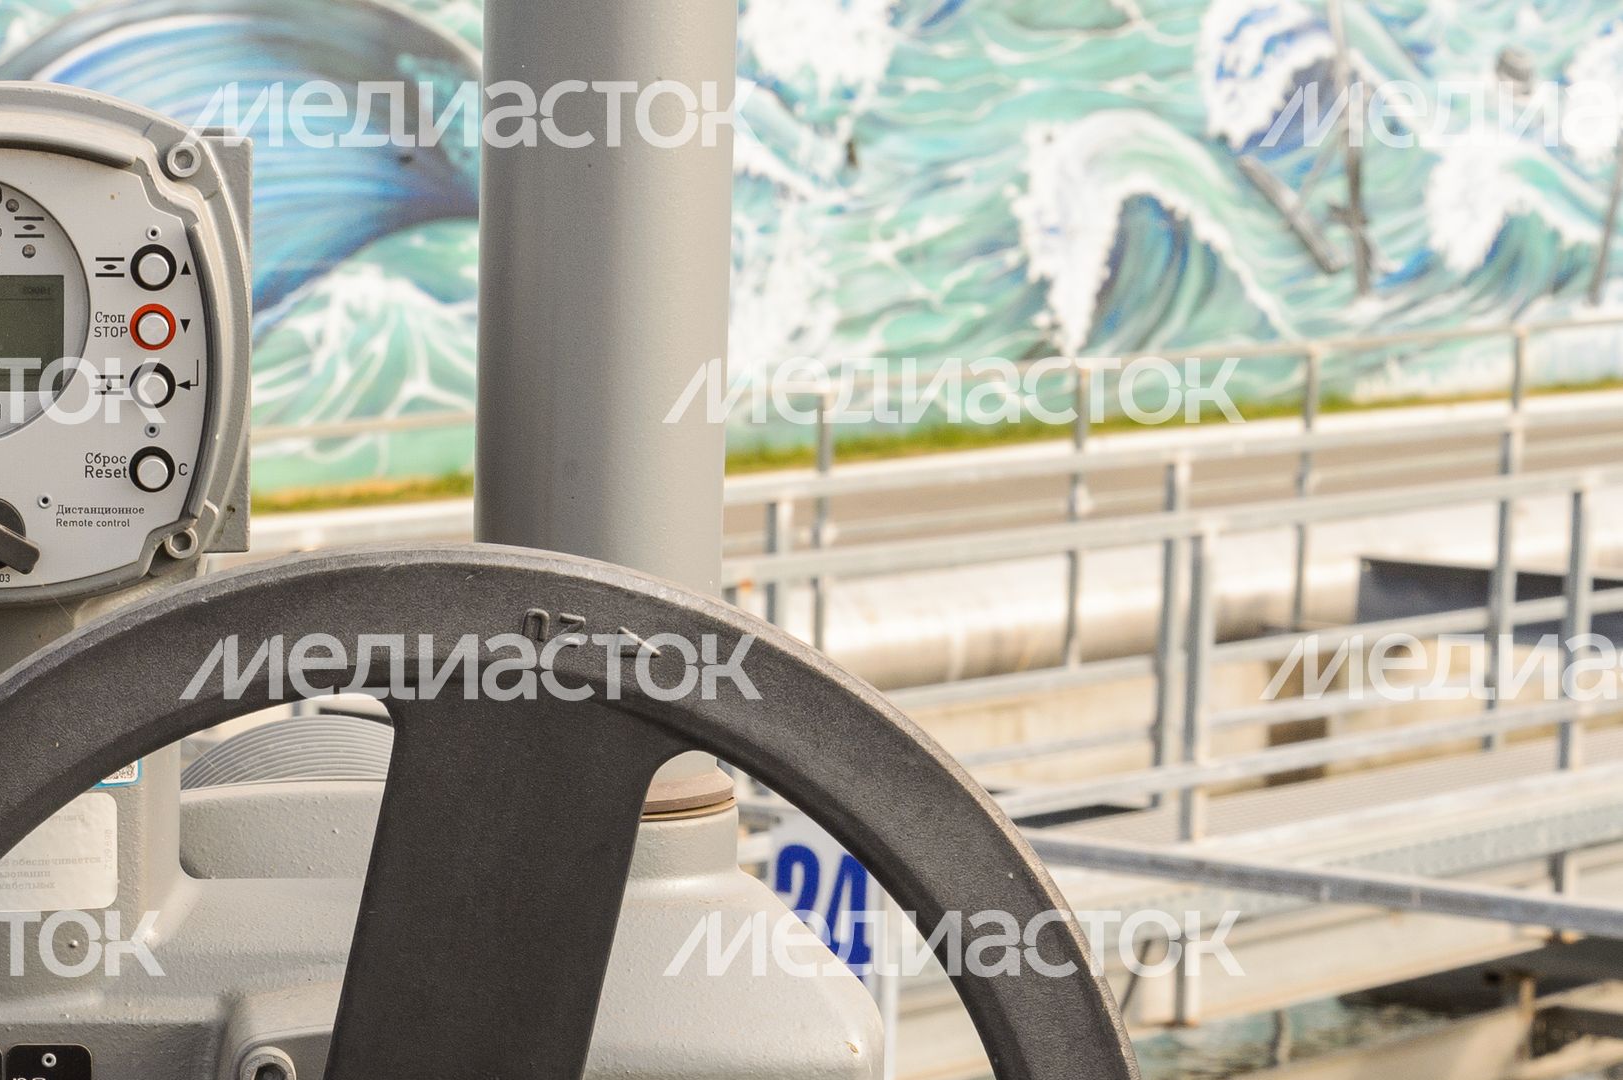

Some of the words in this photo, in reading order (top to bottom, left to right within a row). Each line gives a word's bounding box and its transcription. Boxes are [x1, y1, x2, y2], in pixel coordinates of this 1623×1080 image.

[95, 312, 125, 323] Стоп
[94, 327, 128, 337] STOP
[85, 452, 127, 467] Сброс
[85, 466, 127, 478] Reset
[56, 505, 144, 515] Дистанционное
[56, 519, 93, 527] Remote
[96, 519, 129, 527] control
